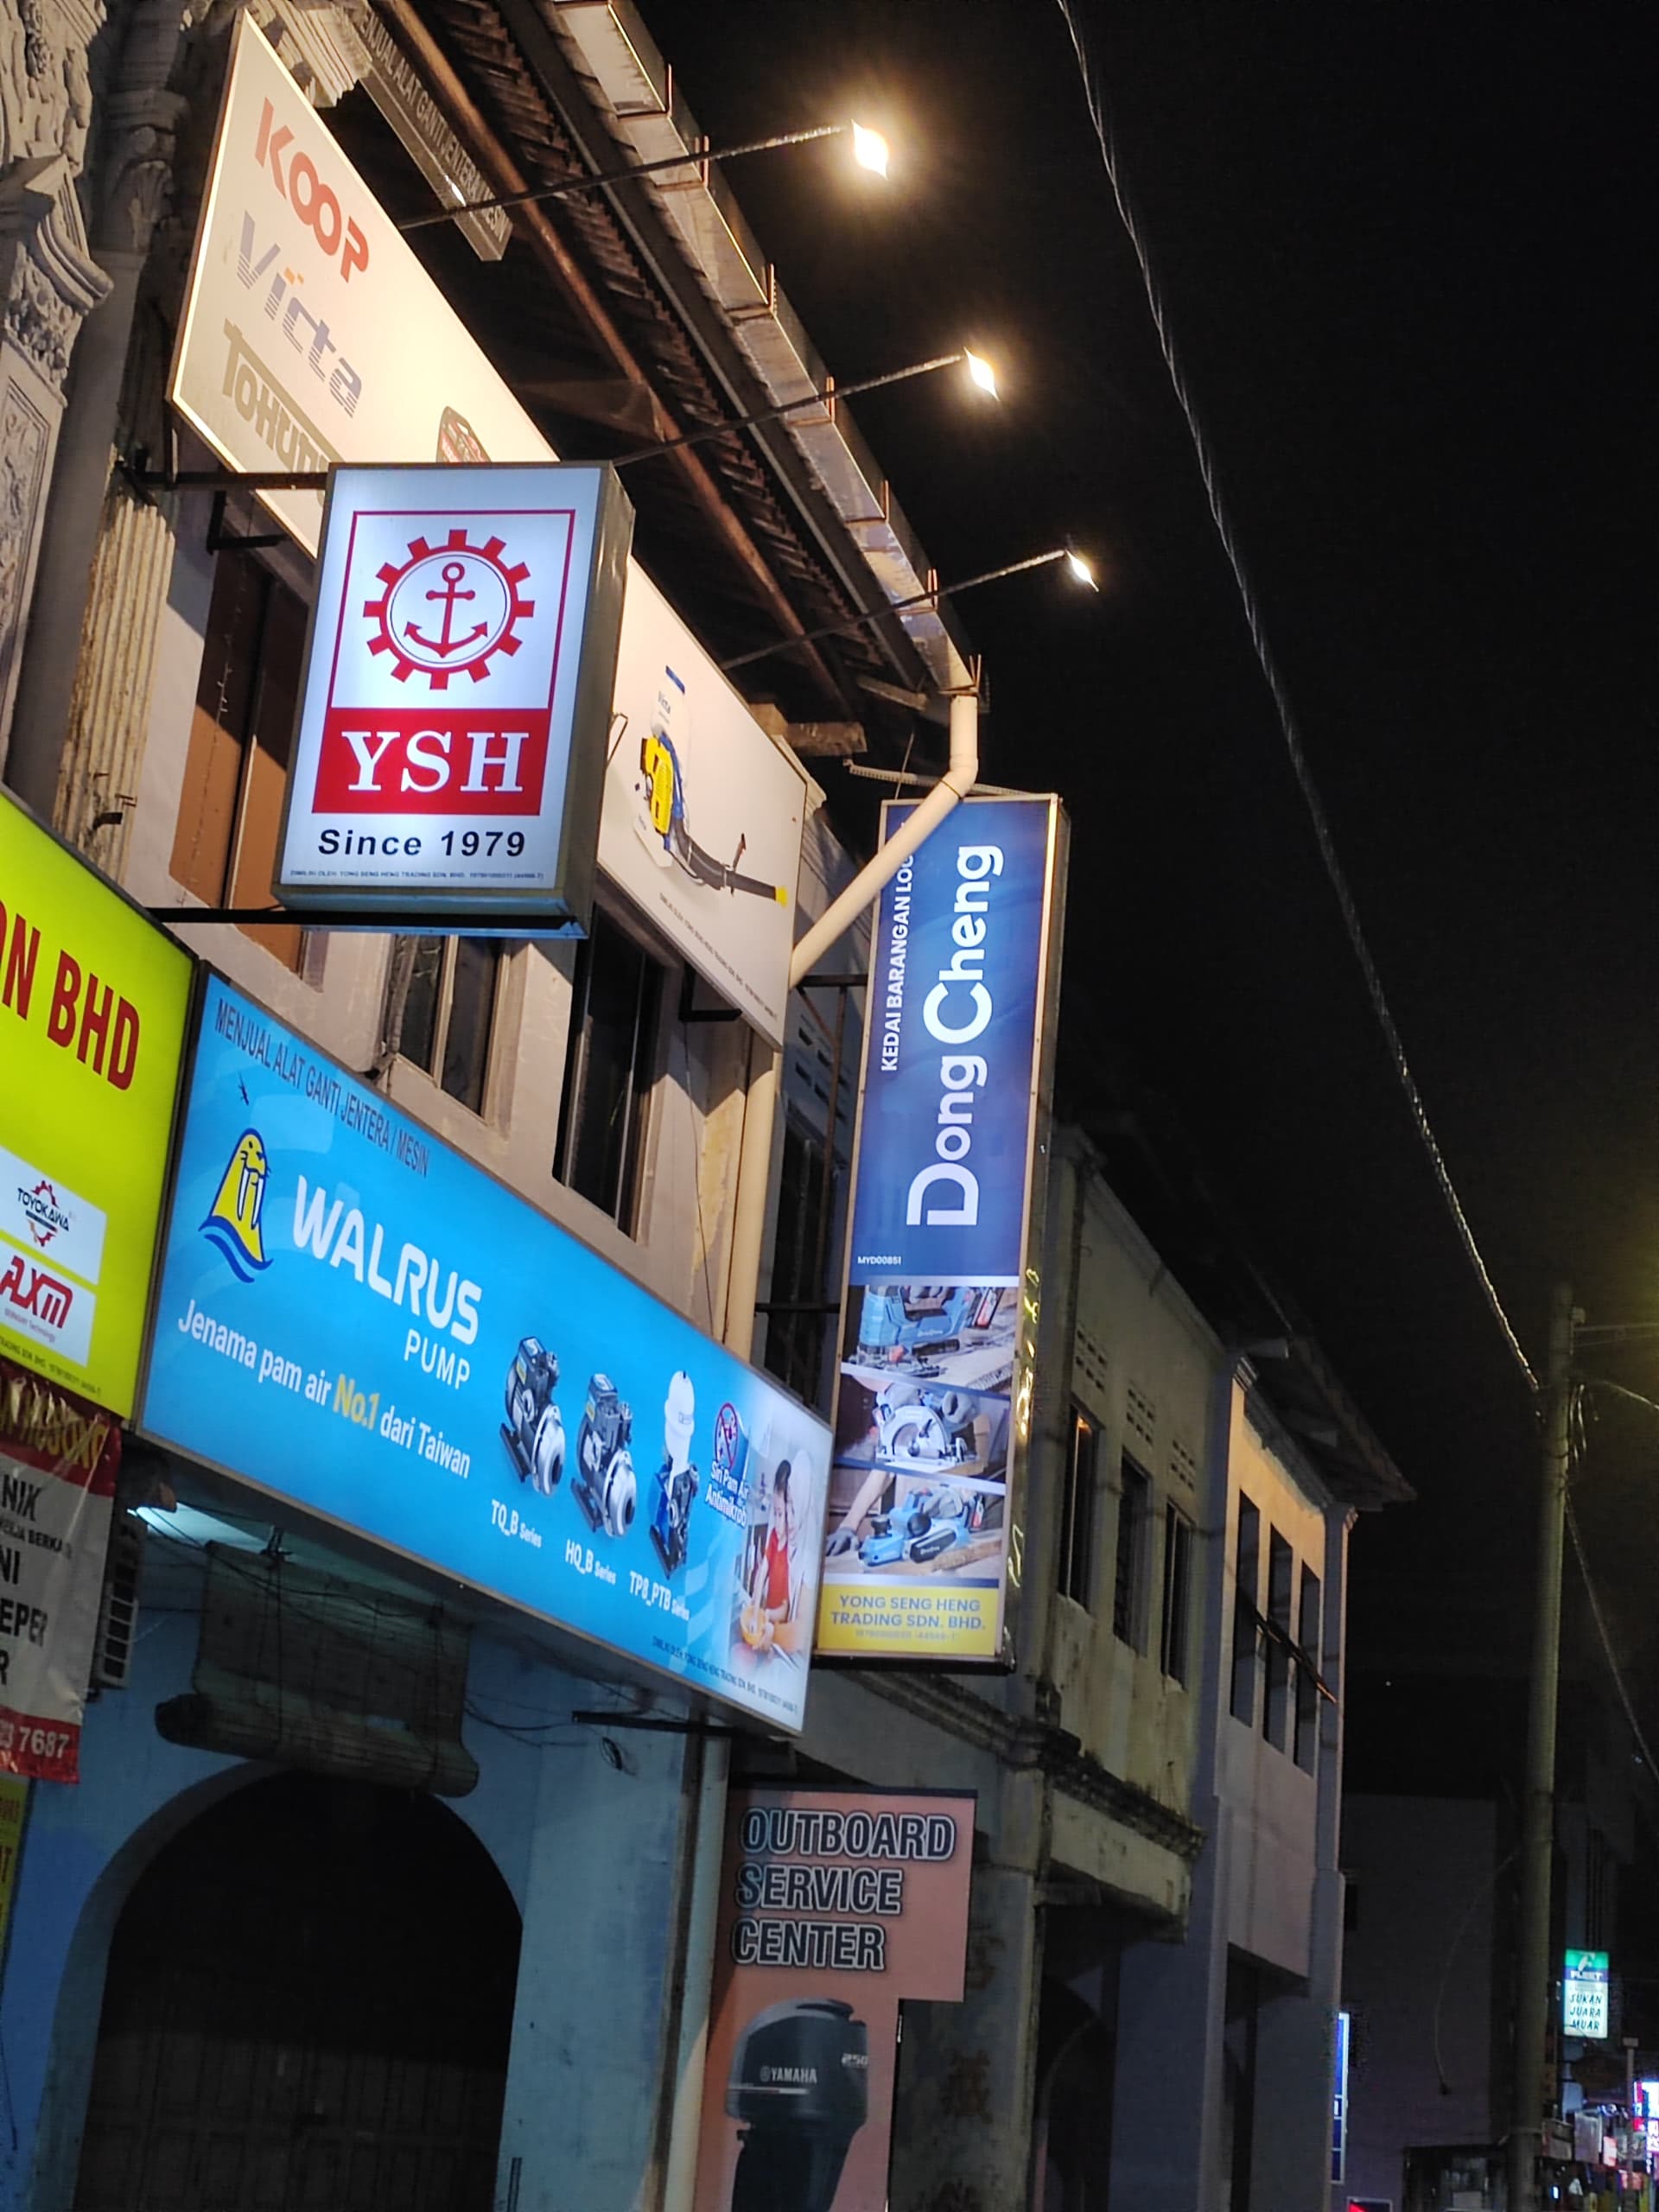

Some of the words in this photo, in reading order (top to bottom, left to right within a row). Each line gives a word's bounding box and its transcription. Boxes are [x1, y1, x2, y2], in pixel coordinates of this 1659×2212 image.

[360, 10, 399, 75] ENJUAL
[392, 58, 422, 106] ALAT
[255, 97, 369, 283] KOOP
[341, 730, 529, 792] YSH
[318, 830, 422, 855] Since
[441, 831, 525, 856] 1979
[886, 896, 912, 1008] BARANGAN
[923, 844, 1004, 1044] Cheng
[0, 899, 41, 1020] N
[47, 950, 140, 1090] BHD
[881, 1013, 902, 1071] KEDAI
[215, 998, 270, 1069] MENJUAL
[273, 1042, 305, 1093] ALAT
[306, 1065, 341, 1113] GANTI
[340, 1093, 391, 1154] JENTERA
[397, 1129, 429, 1179] MESIN
[906, 1053, 988, 1226] Dong
[17, 1187, 70, 1232] TOYOKAWA
[293, 1175, 483, 1345] WALRUS
[178, 1300, 257, 1369] Jenama
[258, 1348, 302, 1392] pam
[305, 1370, 332, 1406] air
[333, 1374, 380, 1431] No.1
[380, 1406, 416, 1449] dari
[417, 1421, 470, 1478] Taiwan
[404, 1328, 470, 1389] PUMP
[831, 1611, 902, 1625] TRADING
[906, 1615, 944, 1627] SDN.
[948, 1617, 986, 1630] BHD.
[839, 1595, 886, 1608] YONG
[890, 1597, 931, 1610] SENG
[937, 1599, 981, 1611] HENG
[19, 1726, 69, 1758] 7687
[741, 1808, 956, 1860] OUTBOARD
[736, 1864, 904, 1916] SERVICE
[732, 1917, 886, 1971] CENTER
[772, 2067, 817, 2083] YAMAHA
